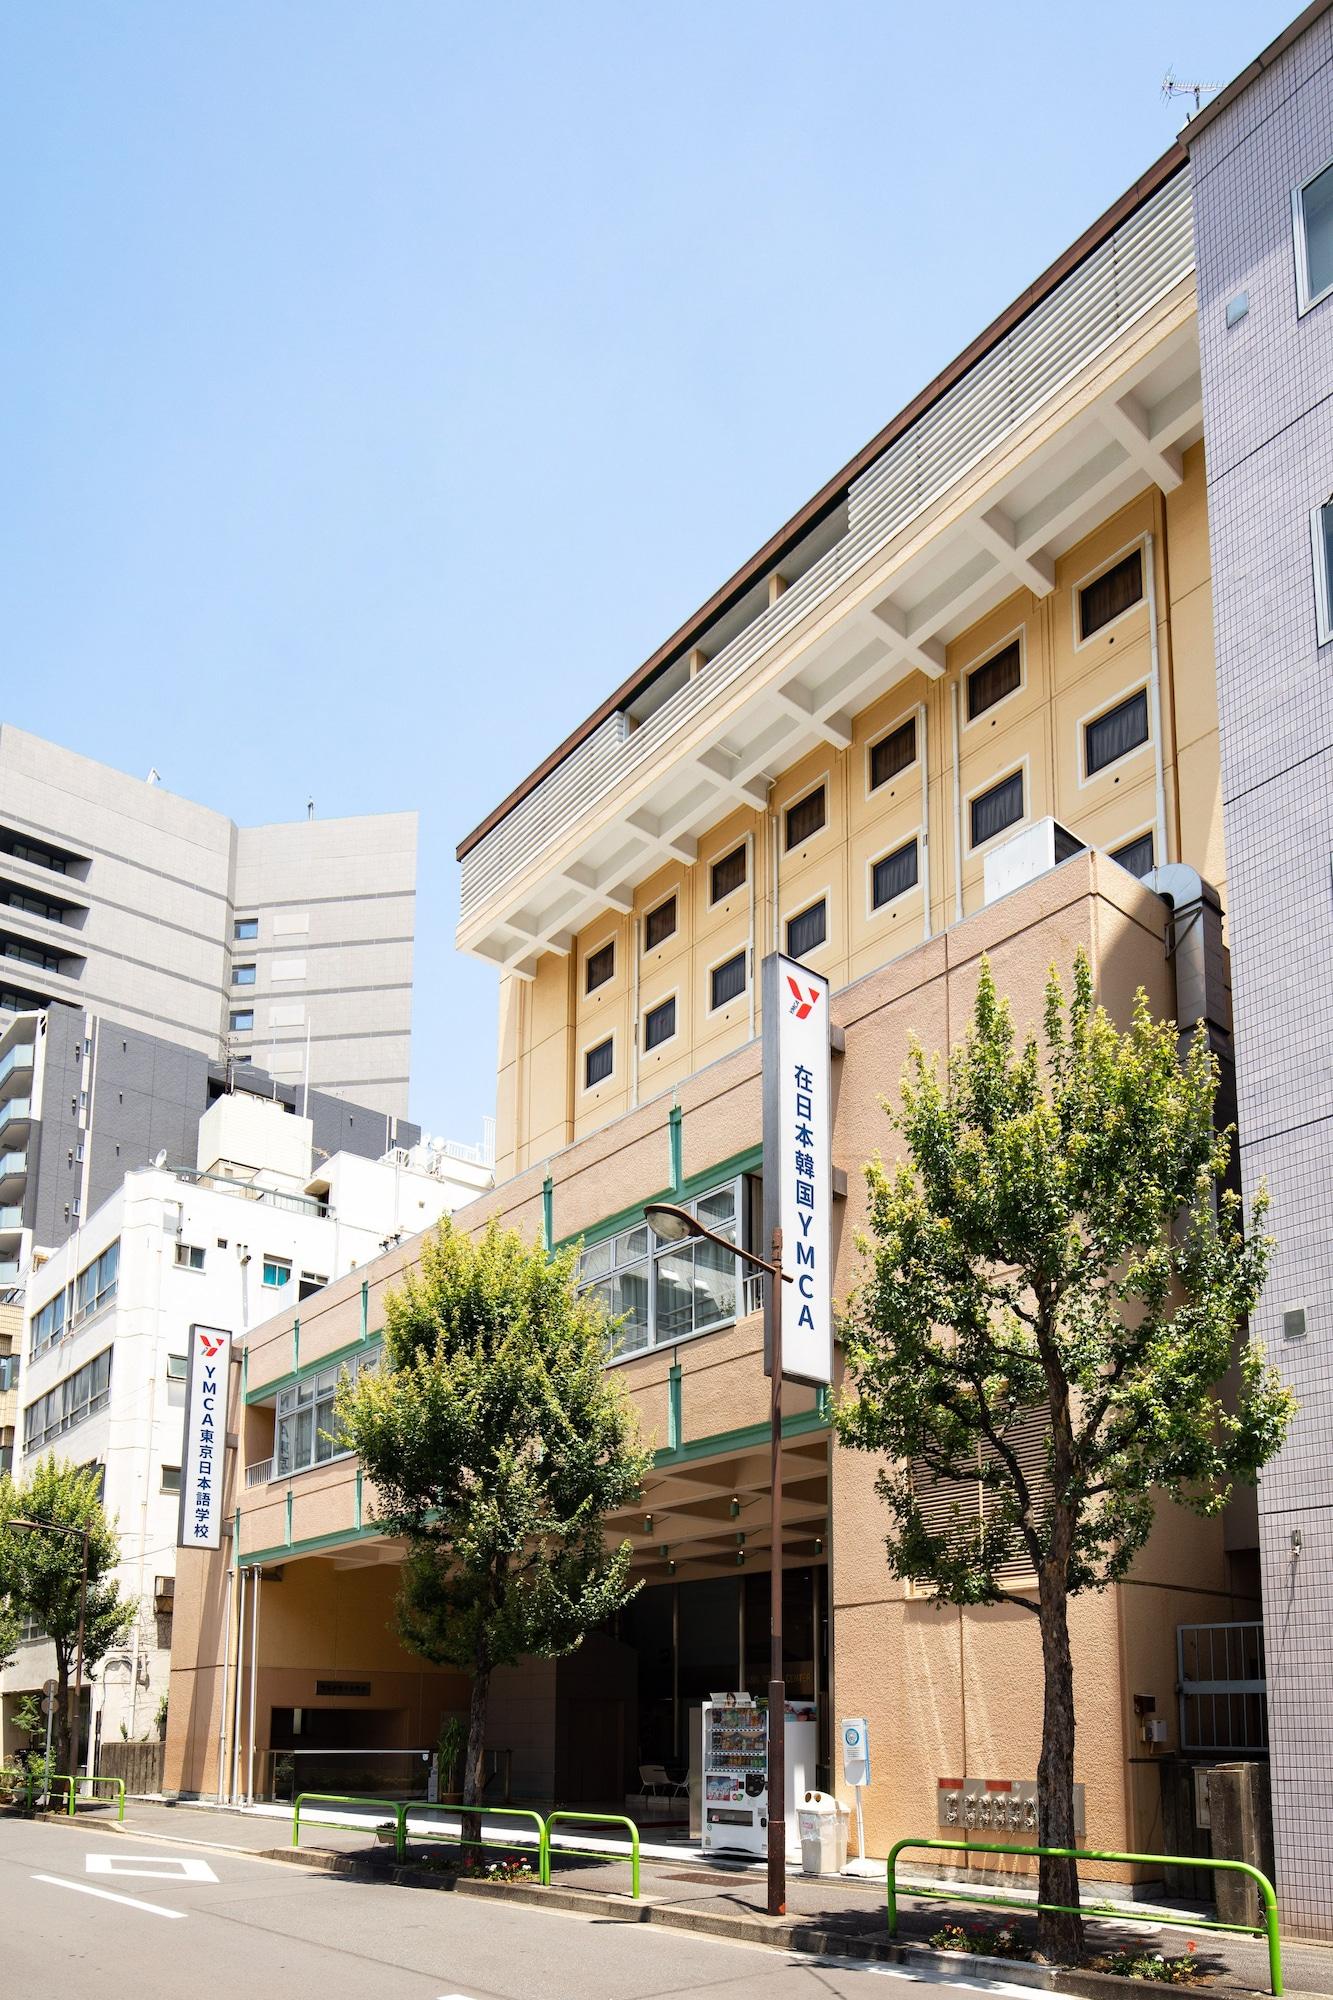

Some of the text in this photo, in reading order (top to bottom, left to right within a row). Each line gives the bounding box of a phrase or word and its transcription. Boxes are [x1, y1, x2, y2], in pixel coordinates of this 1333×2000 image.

[794, 1065, 815, 1330] 在日本韓国YMCA
[194, 1366, 216, 1538] YMCA東京日本語学校
